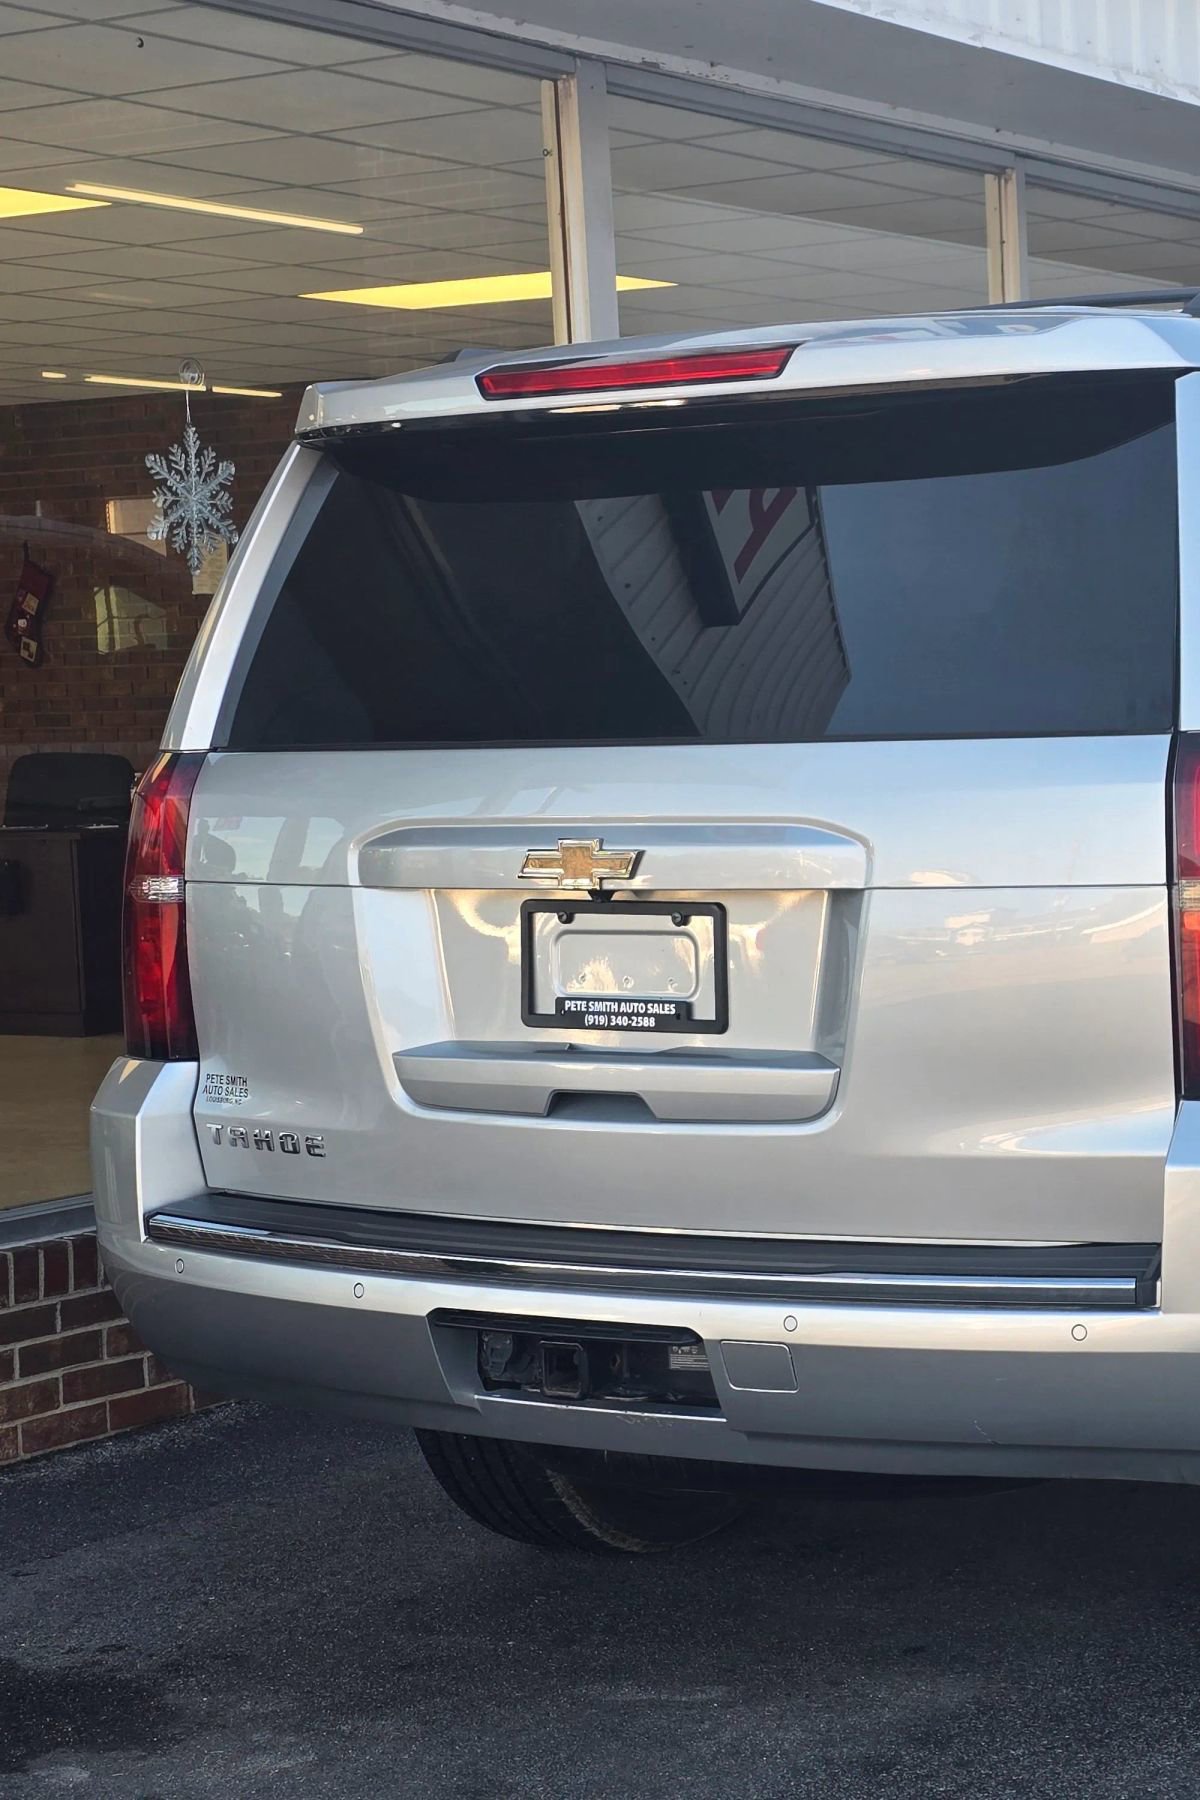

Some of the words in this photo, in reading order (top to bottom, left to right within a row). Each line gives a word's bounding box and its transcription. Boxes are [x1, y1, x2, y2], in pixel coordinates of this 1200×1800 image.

[565, 1000, 587, 1012] PETE
[588, 1001, 618, 1013] SMITH
[619, 1002, 646, 1014] AUTO
[647, 1003, 676, 1015] SALES
[585, 1014, 608, 1026] (919)
[610, 1015, 656, 1027] 340-2588
[206, 1073, 225, 1085] PETE
[225, 1075, 248, 1087] SMITH
[202, 1084, 223, 1095] AUTO
[224, 1086, 249, 1098] SALES
[206, 1123, 326, 1158] TAHOE
